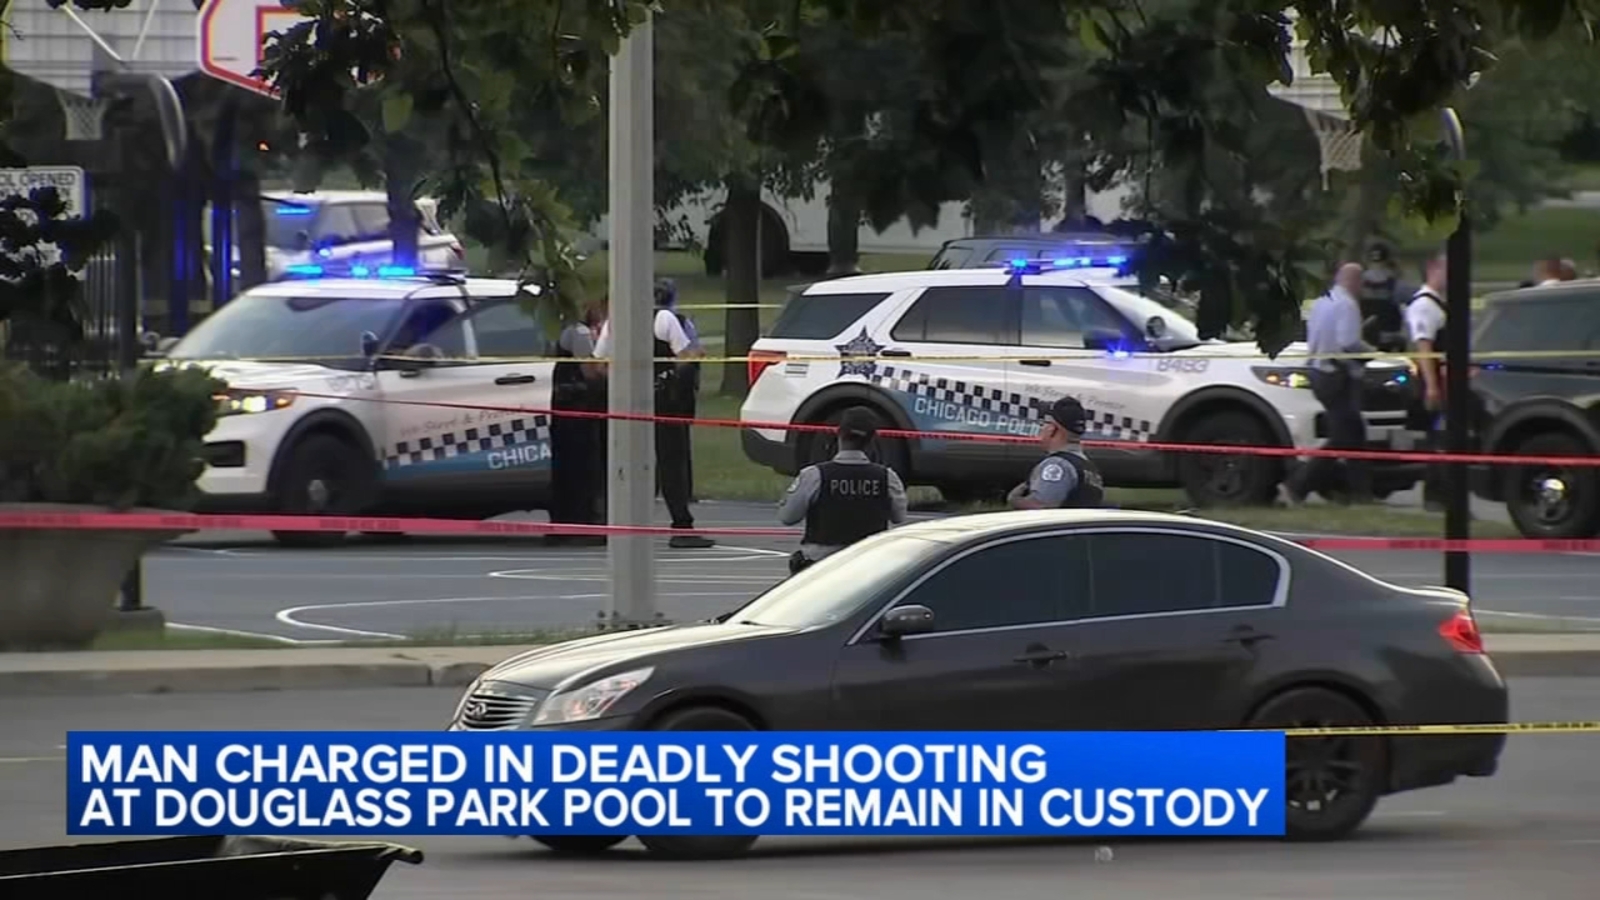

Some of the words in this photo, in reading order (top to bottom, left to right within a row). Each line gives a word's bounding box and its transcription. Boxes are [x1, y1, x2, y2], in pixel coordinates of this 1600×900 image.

[19, 172, 76, 187] OPENED
[914, 397, 991, 427] CHICAGO
[487, 443, 552, 470] CHICA
[829, 479, 881, 496] POLICE
